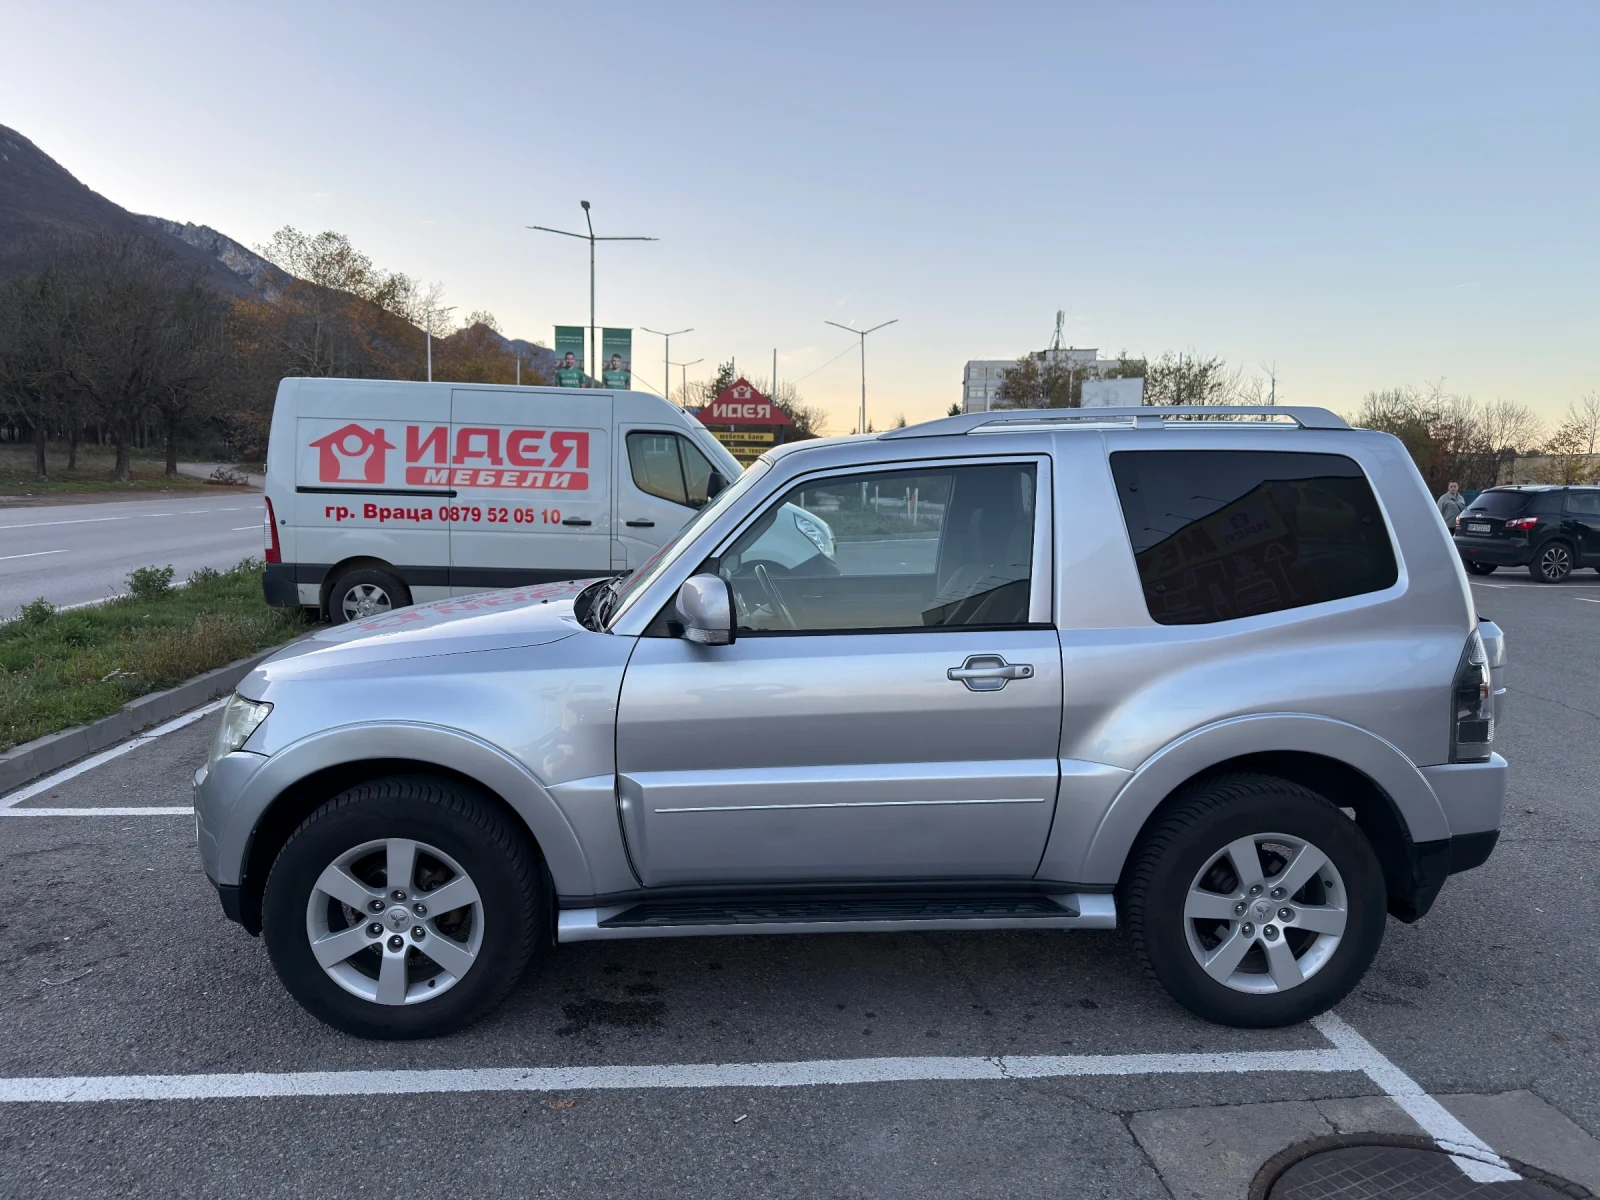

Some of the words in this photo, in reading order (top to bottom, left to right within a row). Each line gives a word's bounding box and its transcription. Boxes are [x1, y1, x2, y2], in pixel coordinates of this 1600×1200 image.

[712, 404, 770, 418] ИДЕЯ
[748, 433, 764, 441] бани
[406, 426, 589, 468] ИДЕЯ
[423, 470, 571, 488] МЕБЕЛИ
[325, 505, 355, 521] гр.
[363, 503, 433, 523] Враца
[438, 506, 482, 523] 0879
[487, 508, 509, 523] 52
[513, 508, 535, 524] 05
[541, 508, 561, 524] 10
